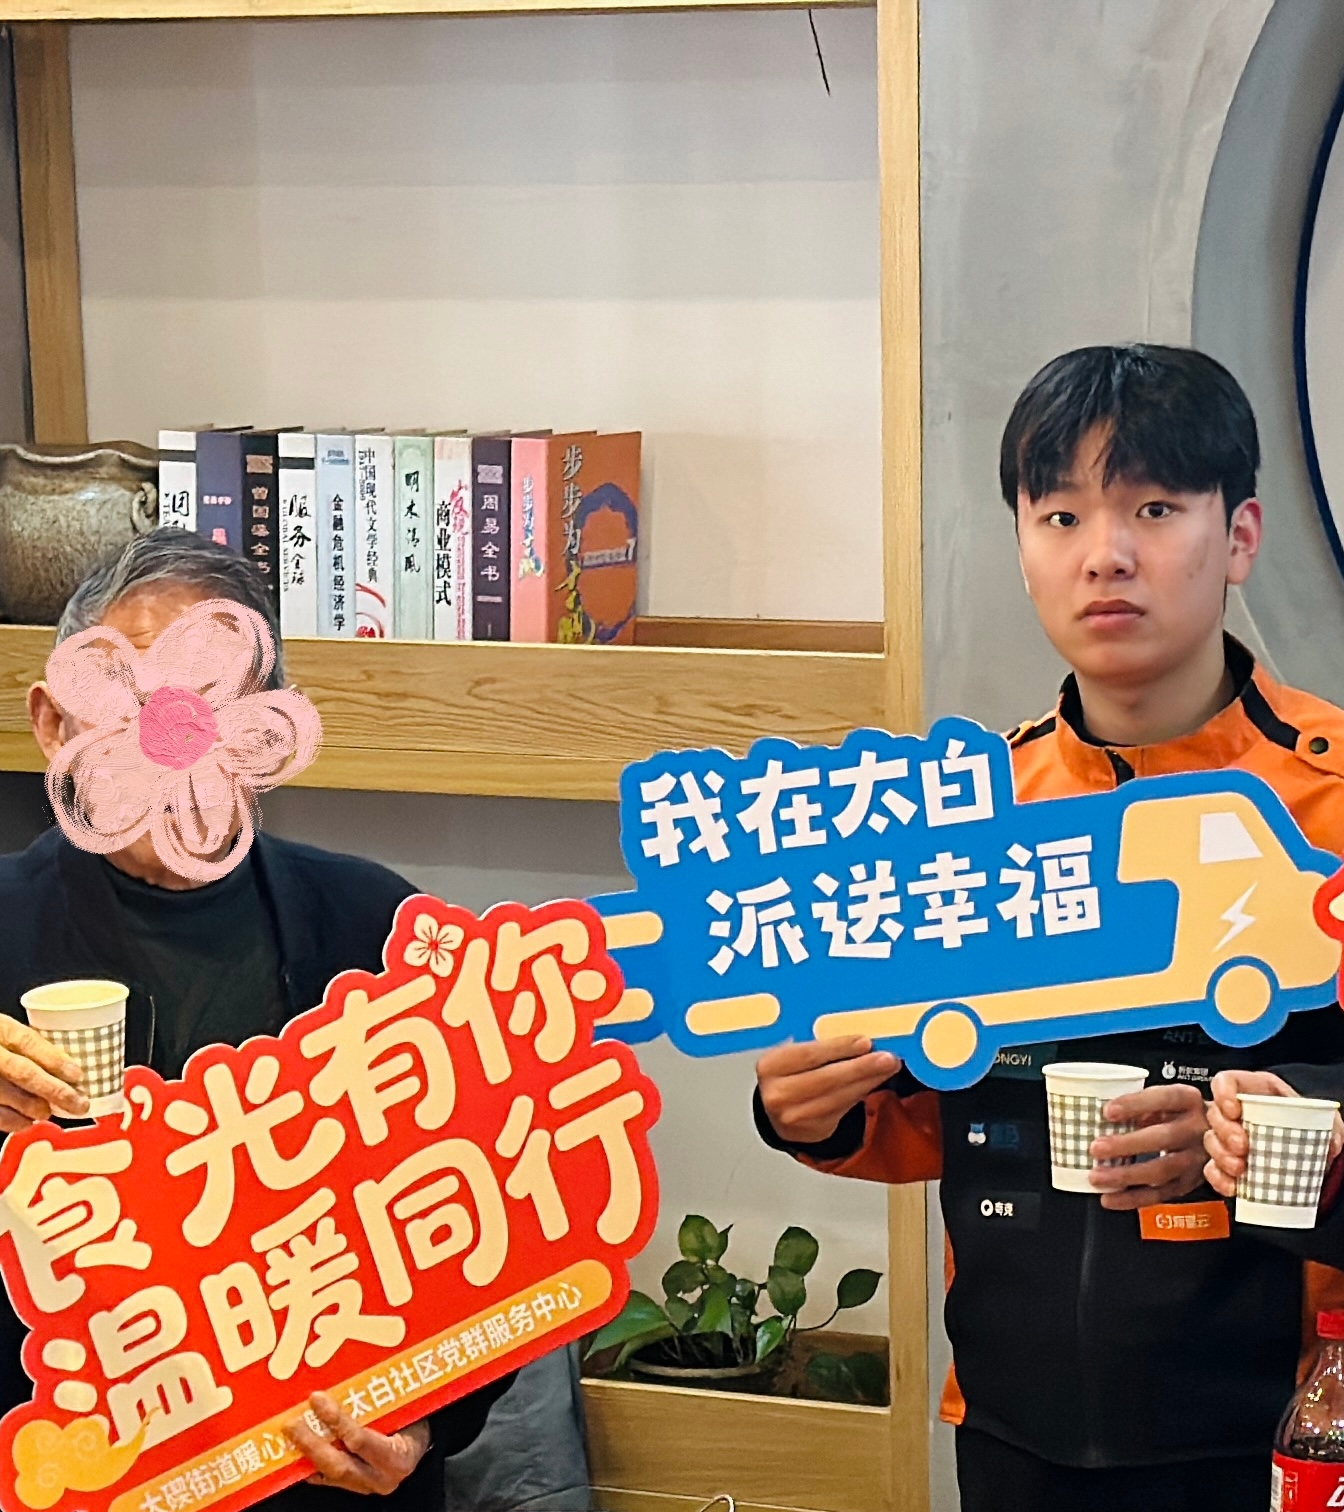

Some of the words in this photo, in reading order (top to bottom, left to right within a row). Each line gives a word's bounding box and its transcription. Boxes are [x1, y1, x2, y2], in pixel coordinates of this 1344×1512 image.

[332, 494, 345, 631] 金融危机经济学
[436, 501, 452, 606] 商业模式
[480, 494, 500, 582] 周易全书
[638, 738, 996, 868] 我在太白
[706, 834, 1103, 976] 派送幸福
[41, 1057, 645, 1451] 温暖同行
[343, 1281, 583, 1420] 太白社区党群服务中心
